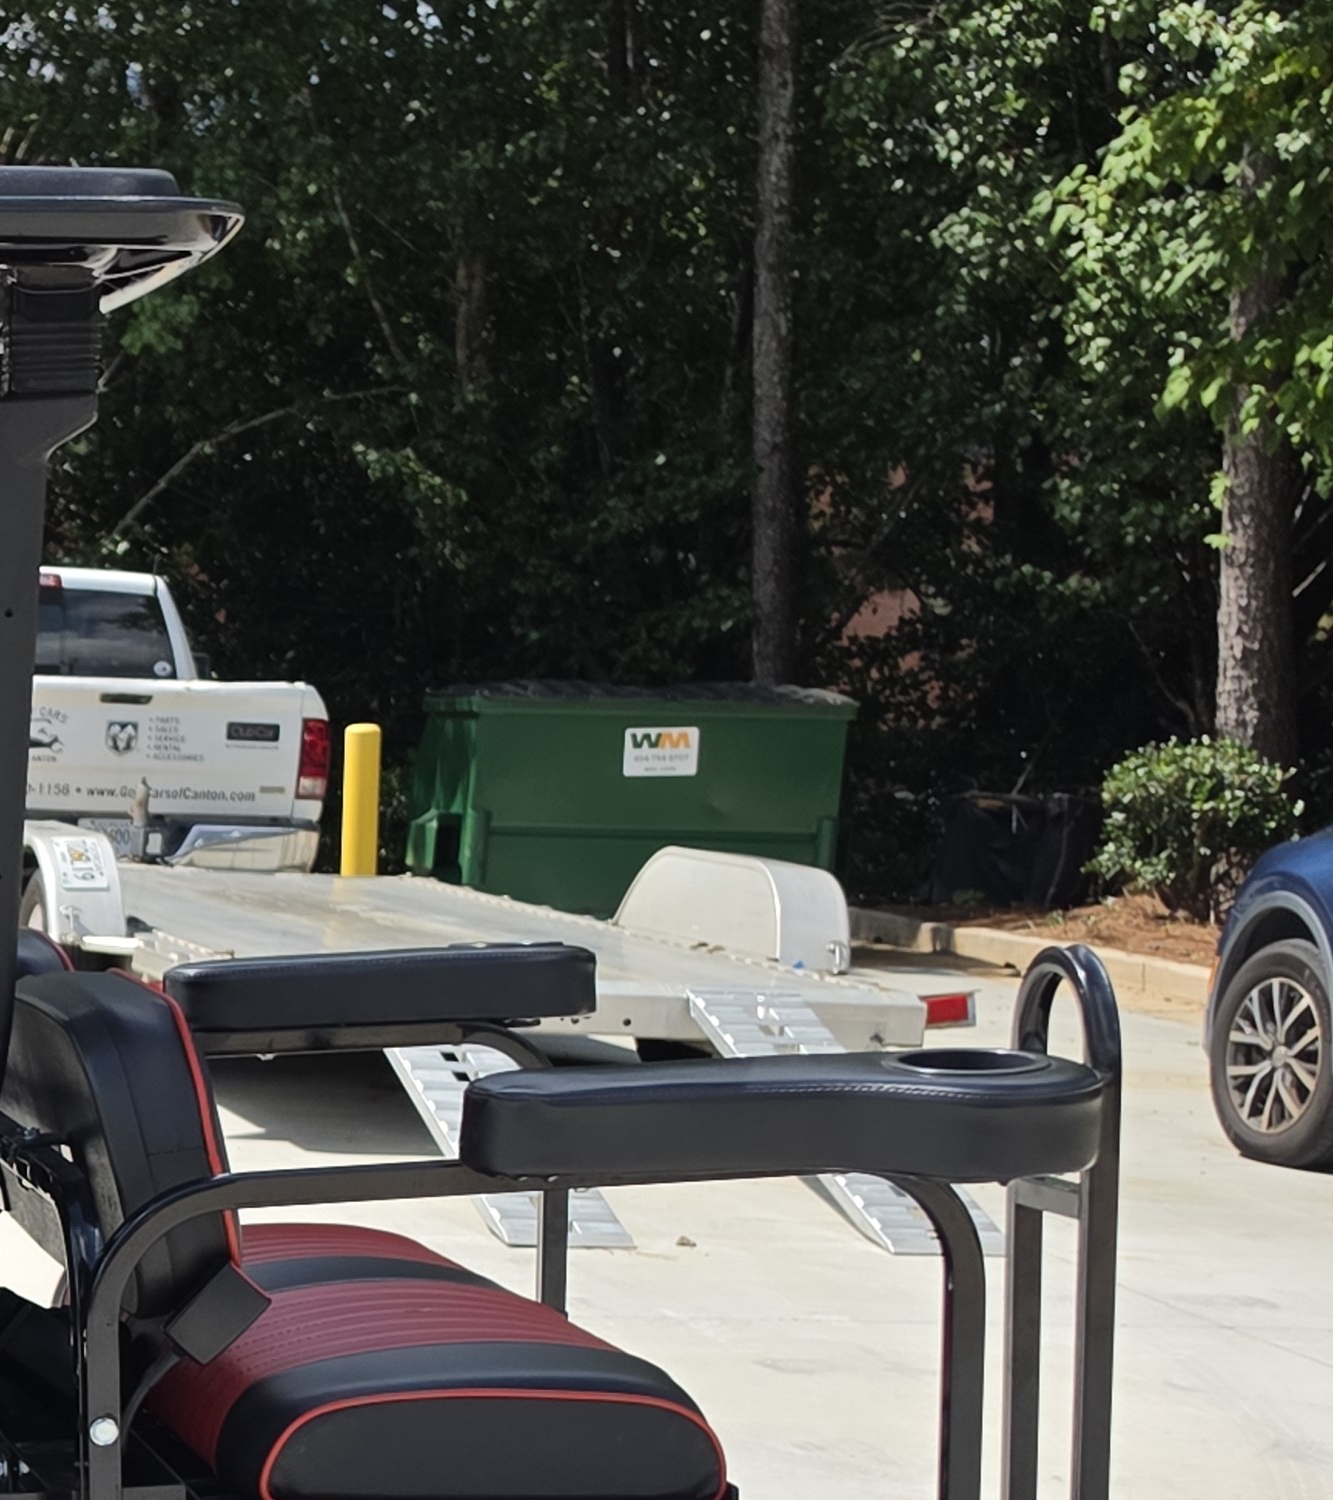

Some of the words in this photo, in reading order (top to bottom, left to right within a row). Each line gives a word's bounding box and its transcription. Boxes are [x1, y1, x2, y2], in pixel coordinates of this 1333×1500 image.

[39, 706, 69, 724] CARS
[155, 716, 180, 724] PARTS
[631, 732, 691, 749] WM
[31, 754, 57, 762] ANTON
